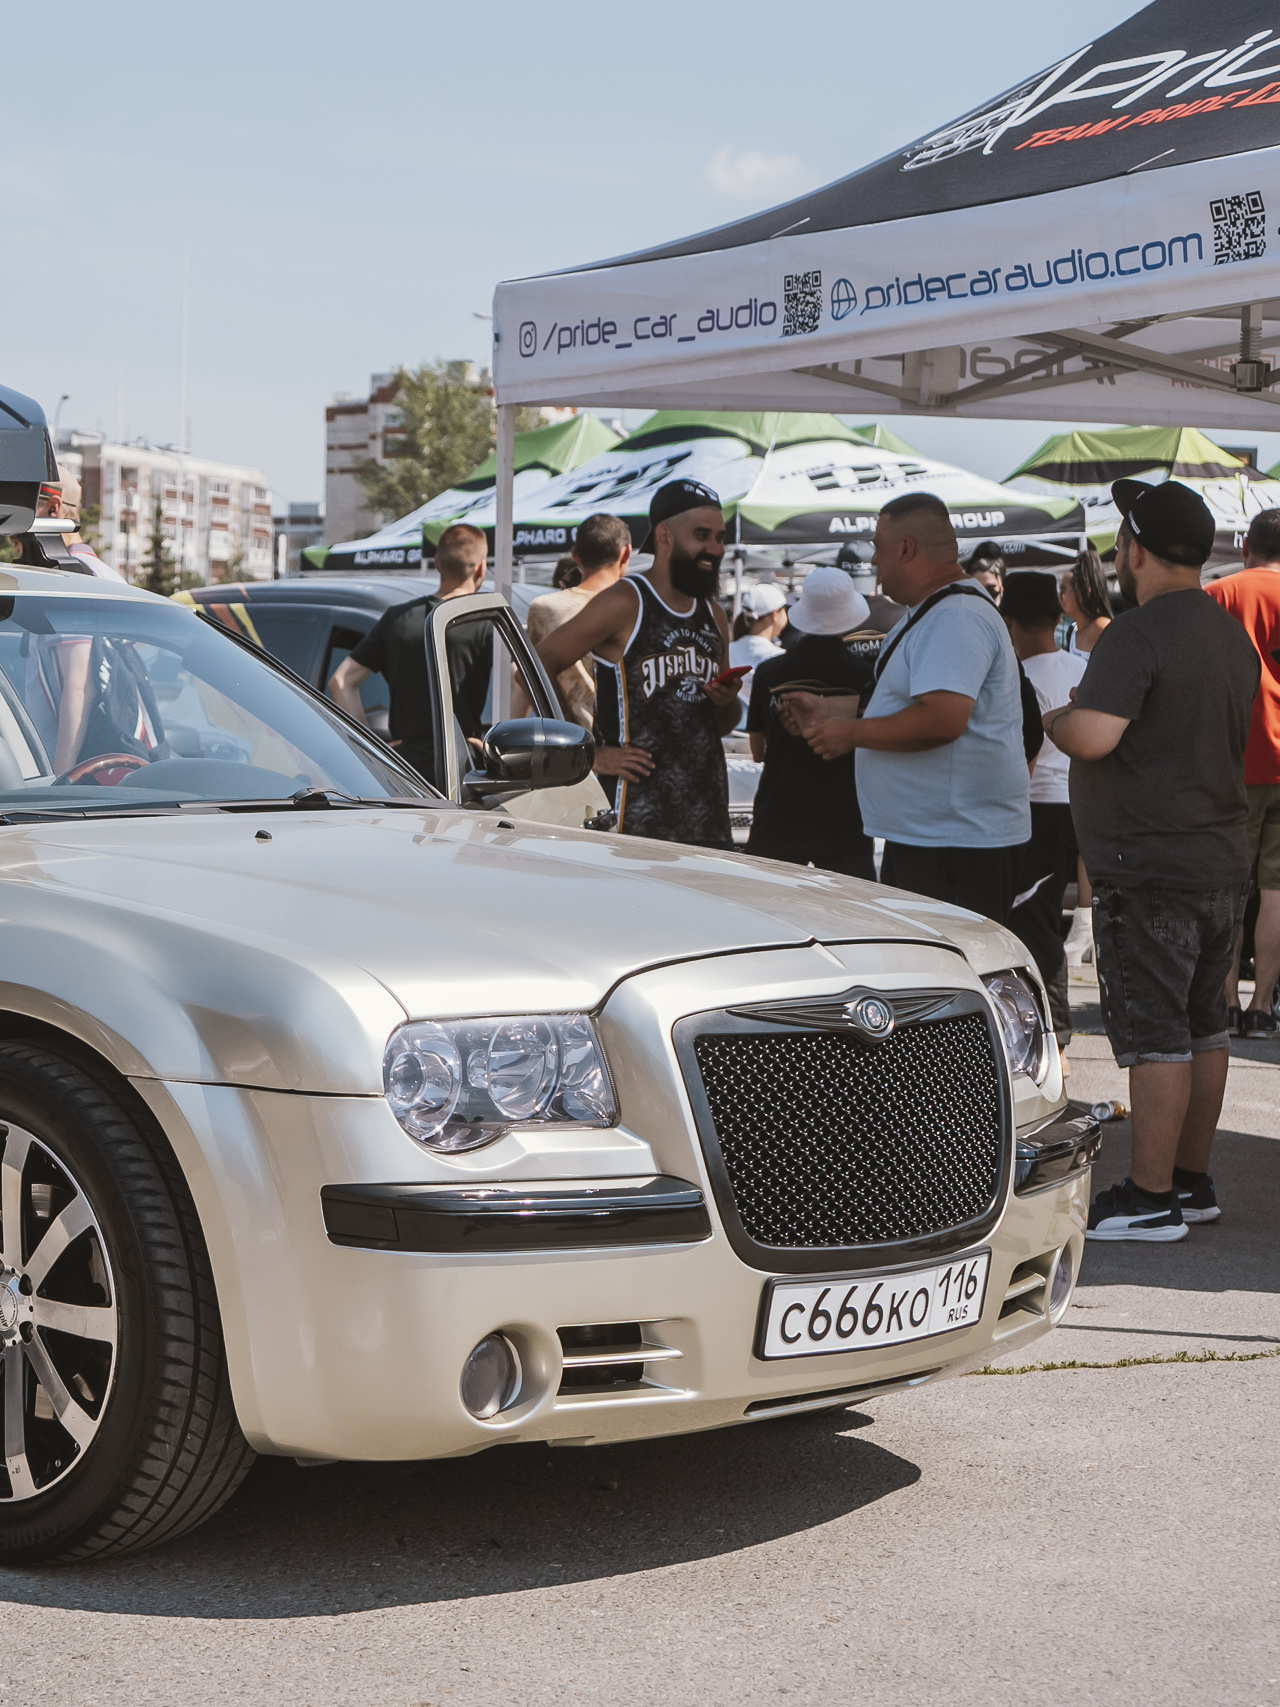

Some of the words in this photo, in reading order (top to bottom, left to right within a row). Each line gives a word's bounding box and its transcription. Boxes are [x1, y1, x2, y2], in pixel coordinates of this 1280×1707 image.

[1013, 115, 1131, 151] TEAM
[1125, 89, 1252, 127] PRIDE
[859, 233, 1203, 316] pridecaraudio.com
[949, 511, 1005, 529] ROUP
[680, 628, 690, 637] TO
[938, 1260, 979, 1308] 116
[947, 1304, 969, 1324] RUS
